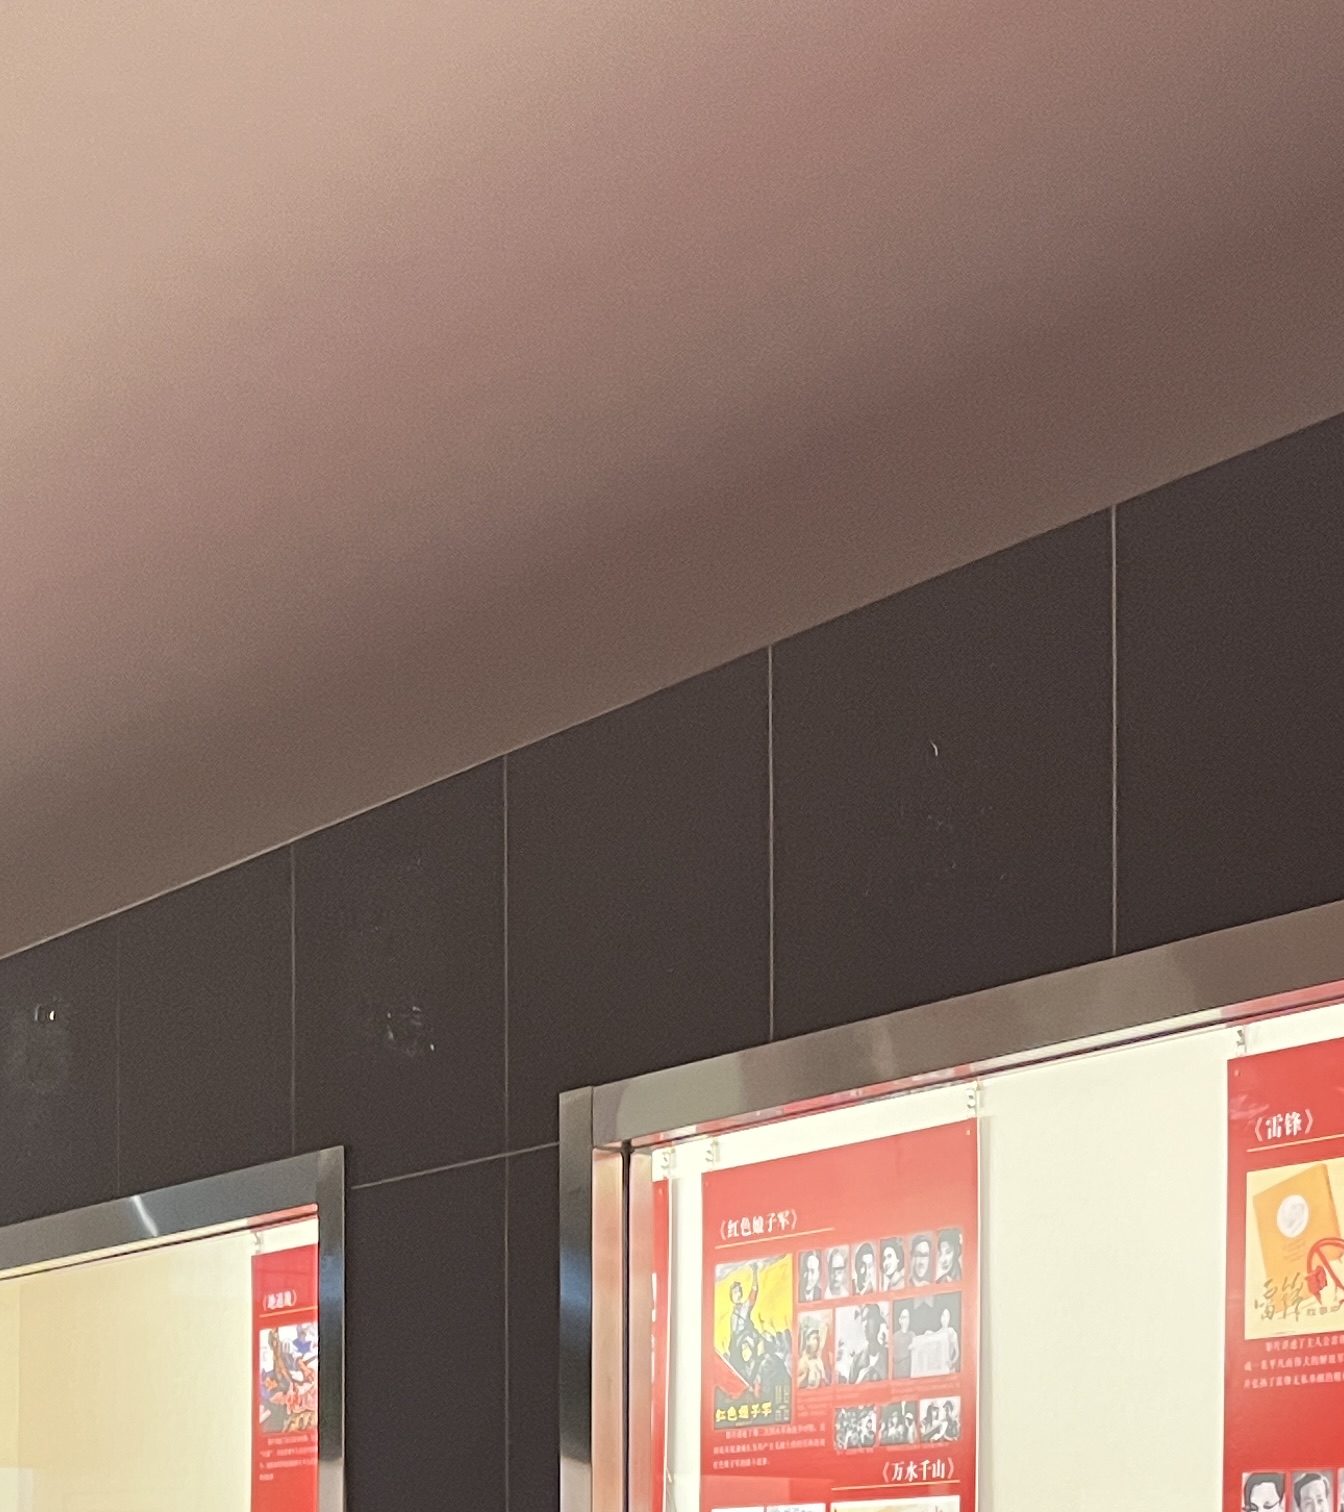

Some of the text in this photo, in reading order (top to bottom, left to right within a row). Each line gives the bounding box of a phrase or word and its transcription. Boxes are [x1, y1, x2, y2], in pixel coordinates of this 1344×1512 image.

[1254, 1109, 1314, 1142] 《雷锋》
[720, 1209, 797, 1240] 《红色娘子军》
[882, 1457, 955, 1483] 《万水千山》
